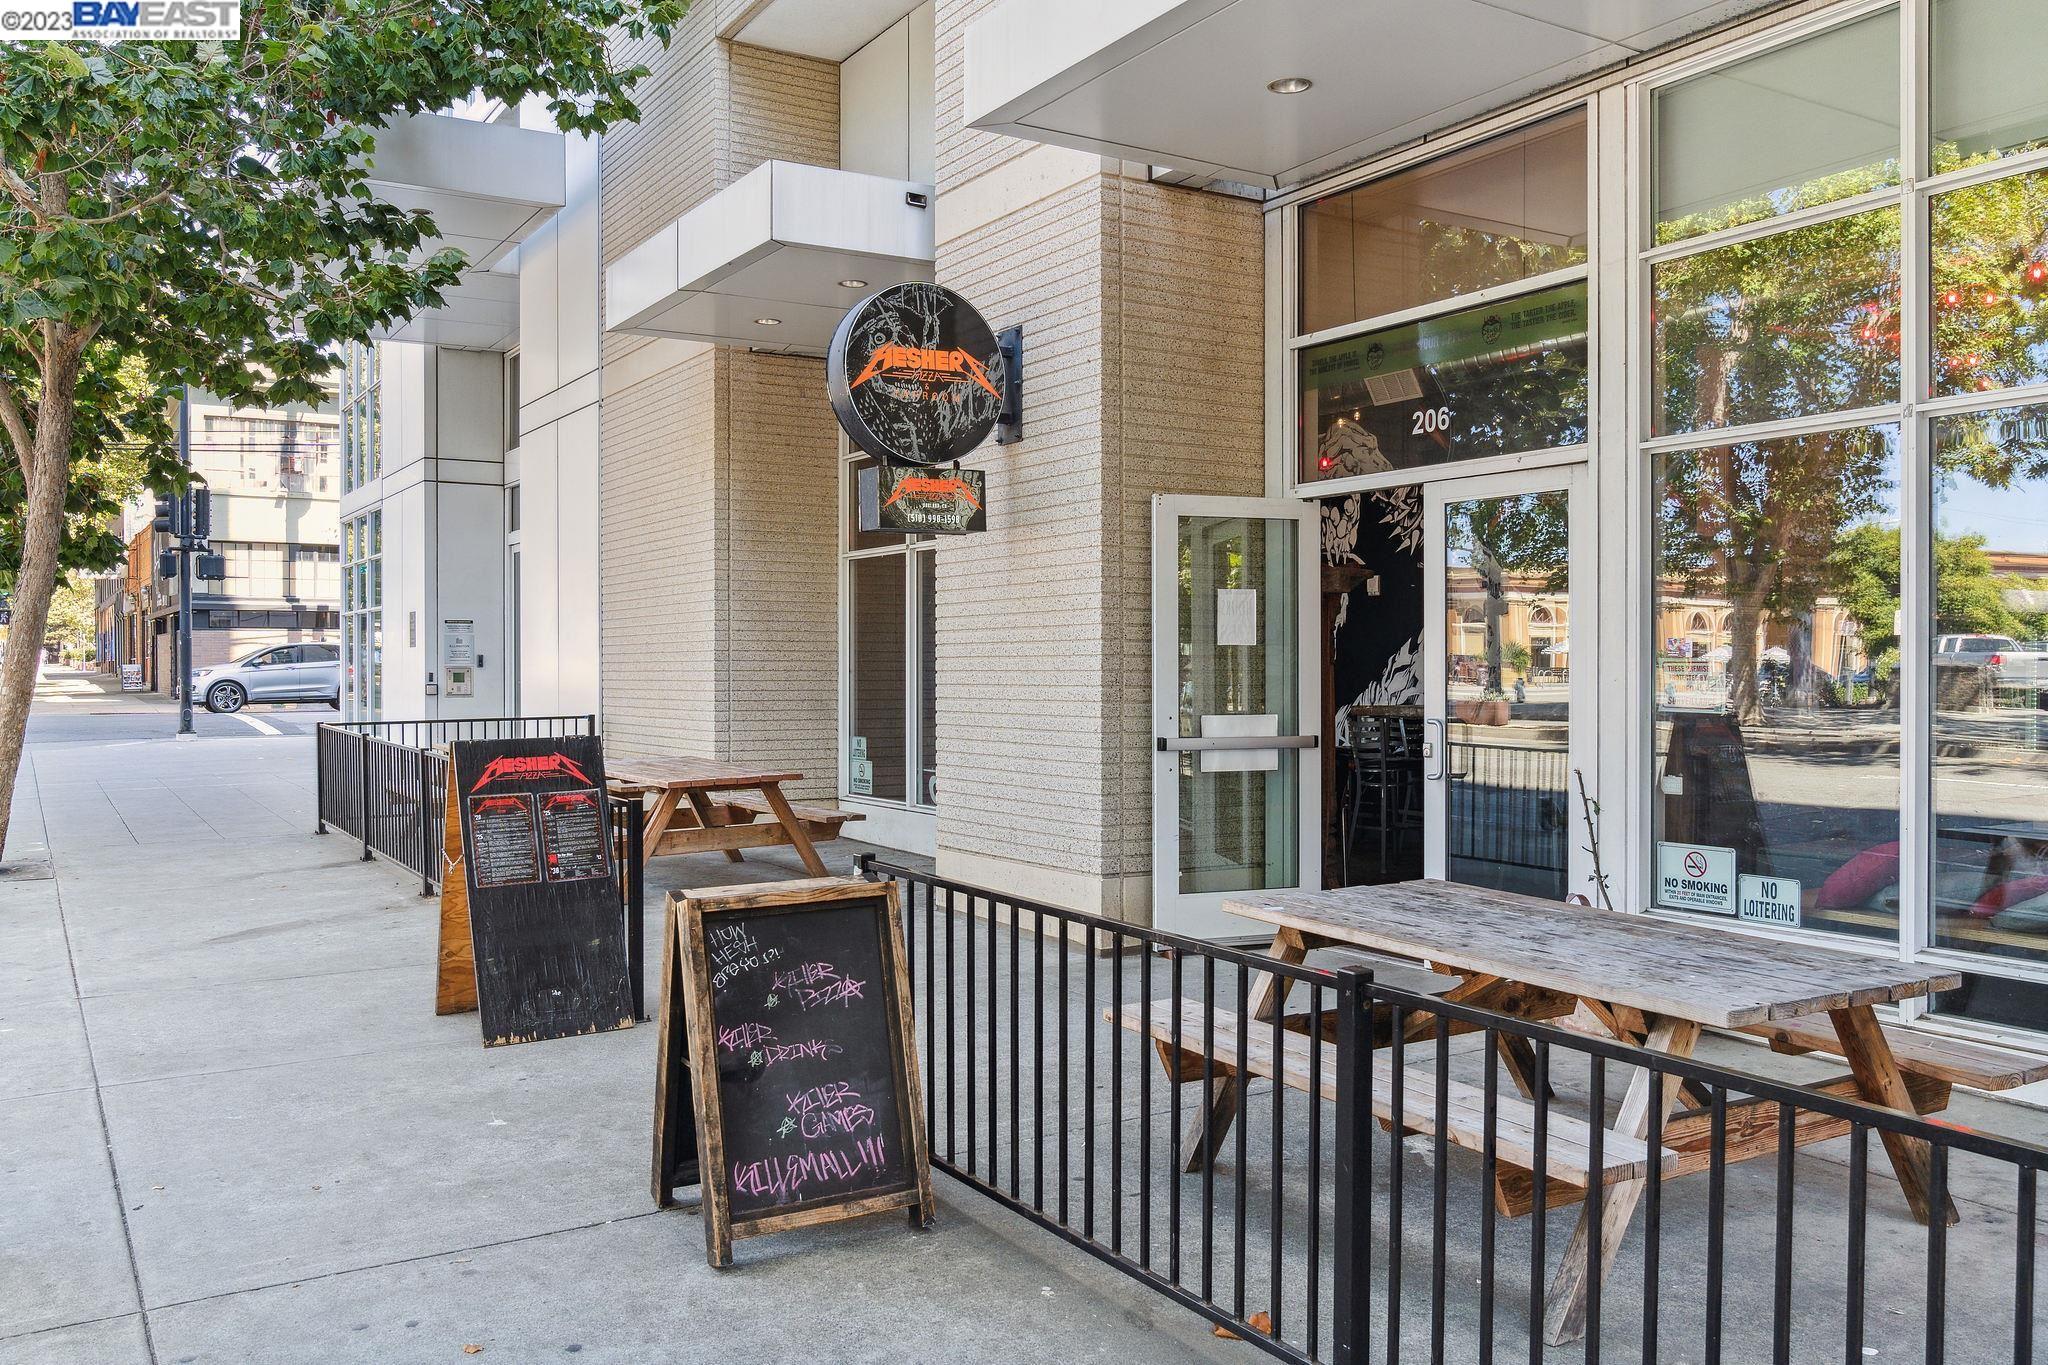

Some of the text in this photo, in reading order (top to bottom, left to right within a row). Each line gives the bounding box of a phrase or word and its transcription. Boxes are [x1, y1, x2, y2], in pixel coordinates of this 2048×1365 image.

[1411, 406, 1450, 435] 206
[1664, 877, 1728, 894] NO SMOKING
[1761, 881, 1777, 899] NO
[1744, 898, 1795, 922] LOITERING
[711, 936, 758, 965] HESH
